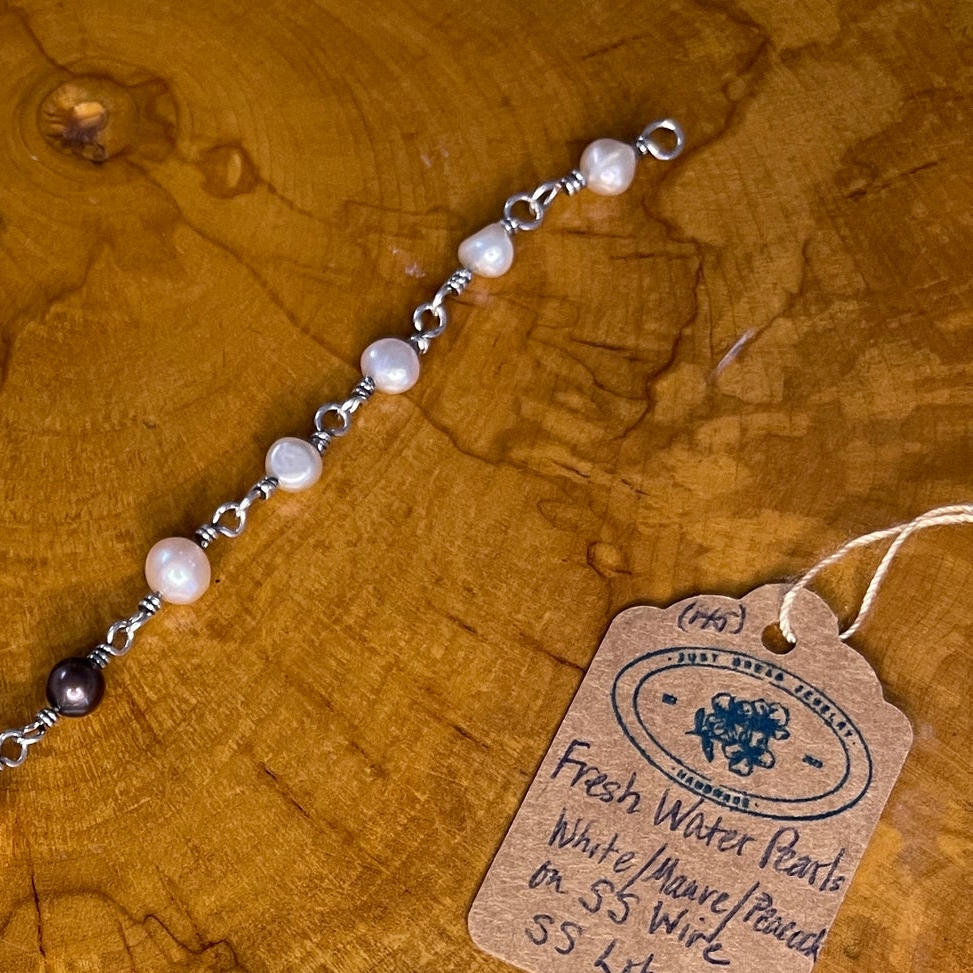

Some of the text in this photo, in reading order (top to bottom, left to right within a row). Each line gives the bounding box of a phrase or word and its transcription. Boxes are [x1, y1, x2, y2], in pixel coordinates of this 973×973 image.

[550, 739, 846, 892] Fresh Water Pearls
[525, 913, 583, 955] SS
[528, 859, 731, 965] on SS Wire
